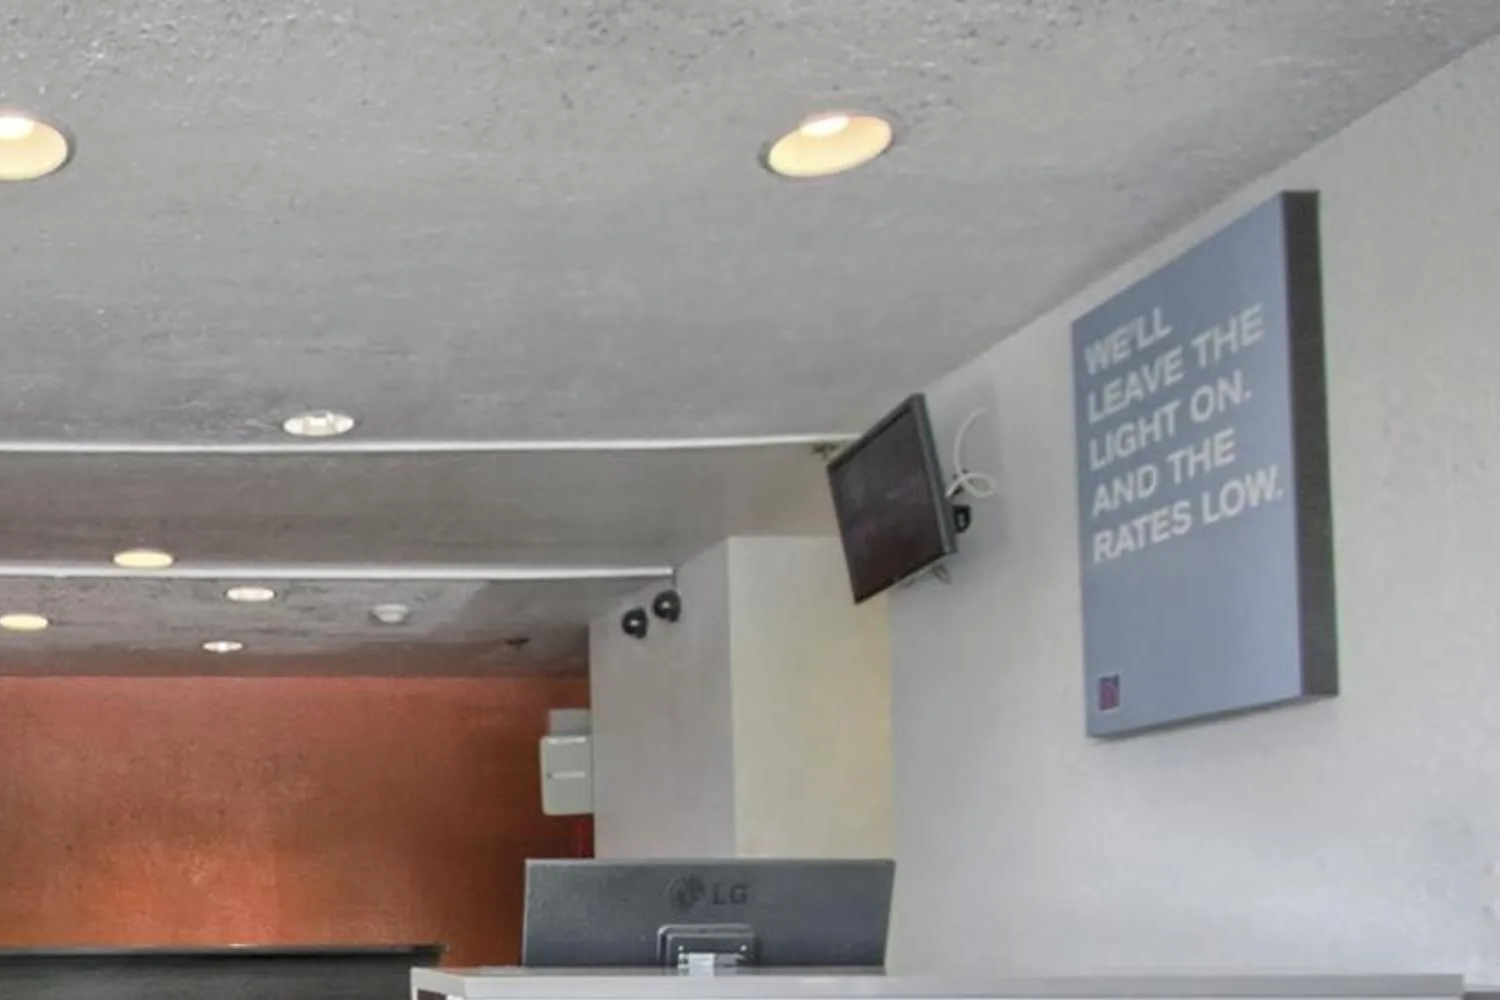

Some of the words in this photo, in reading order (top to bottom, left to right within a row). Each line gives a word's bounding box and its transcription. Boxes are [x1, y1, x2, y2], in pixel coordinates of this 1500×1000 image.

[1084, 307, 1173, 376] WE'LL
[1087, 350, 1184, 425] LEAVE
[1191, 305, 1266, 372] THE
[1088, 399, 1181, 471] LIGHT
[1189, 369, 1252, 423] ON.
[1092, 463, 1159, 517] AND
[1166, 428, 1237, 489] THE
[1094, 498, 1193, 564] RATES
[1202, 464, 1285, 526] LOW.
[712, 884, 752, 907] LG
